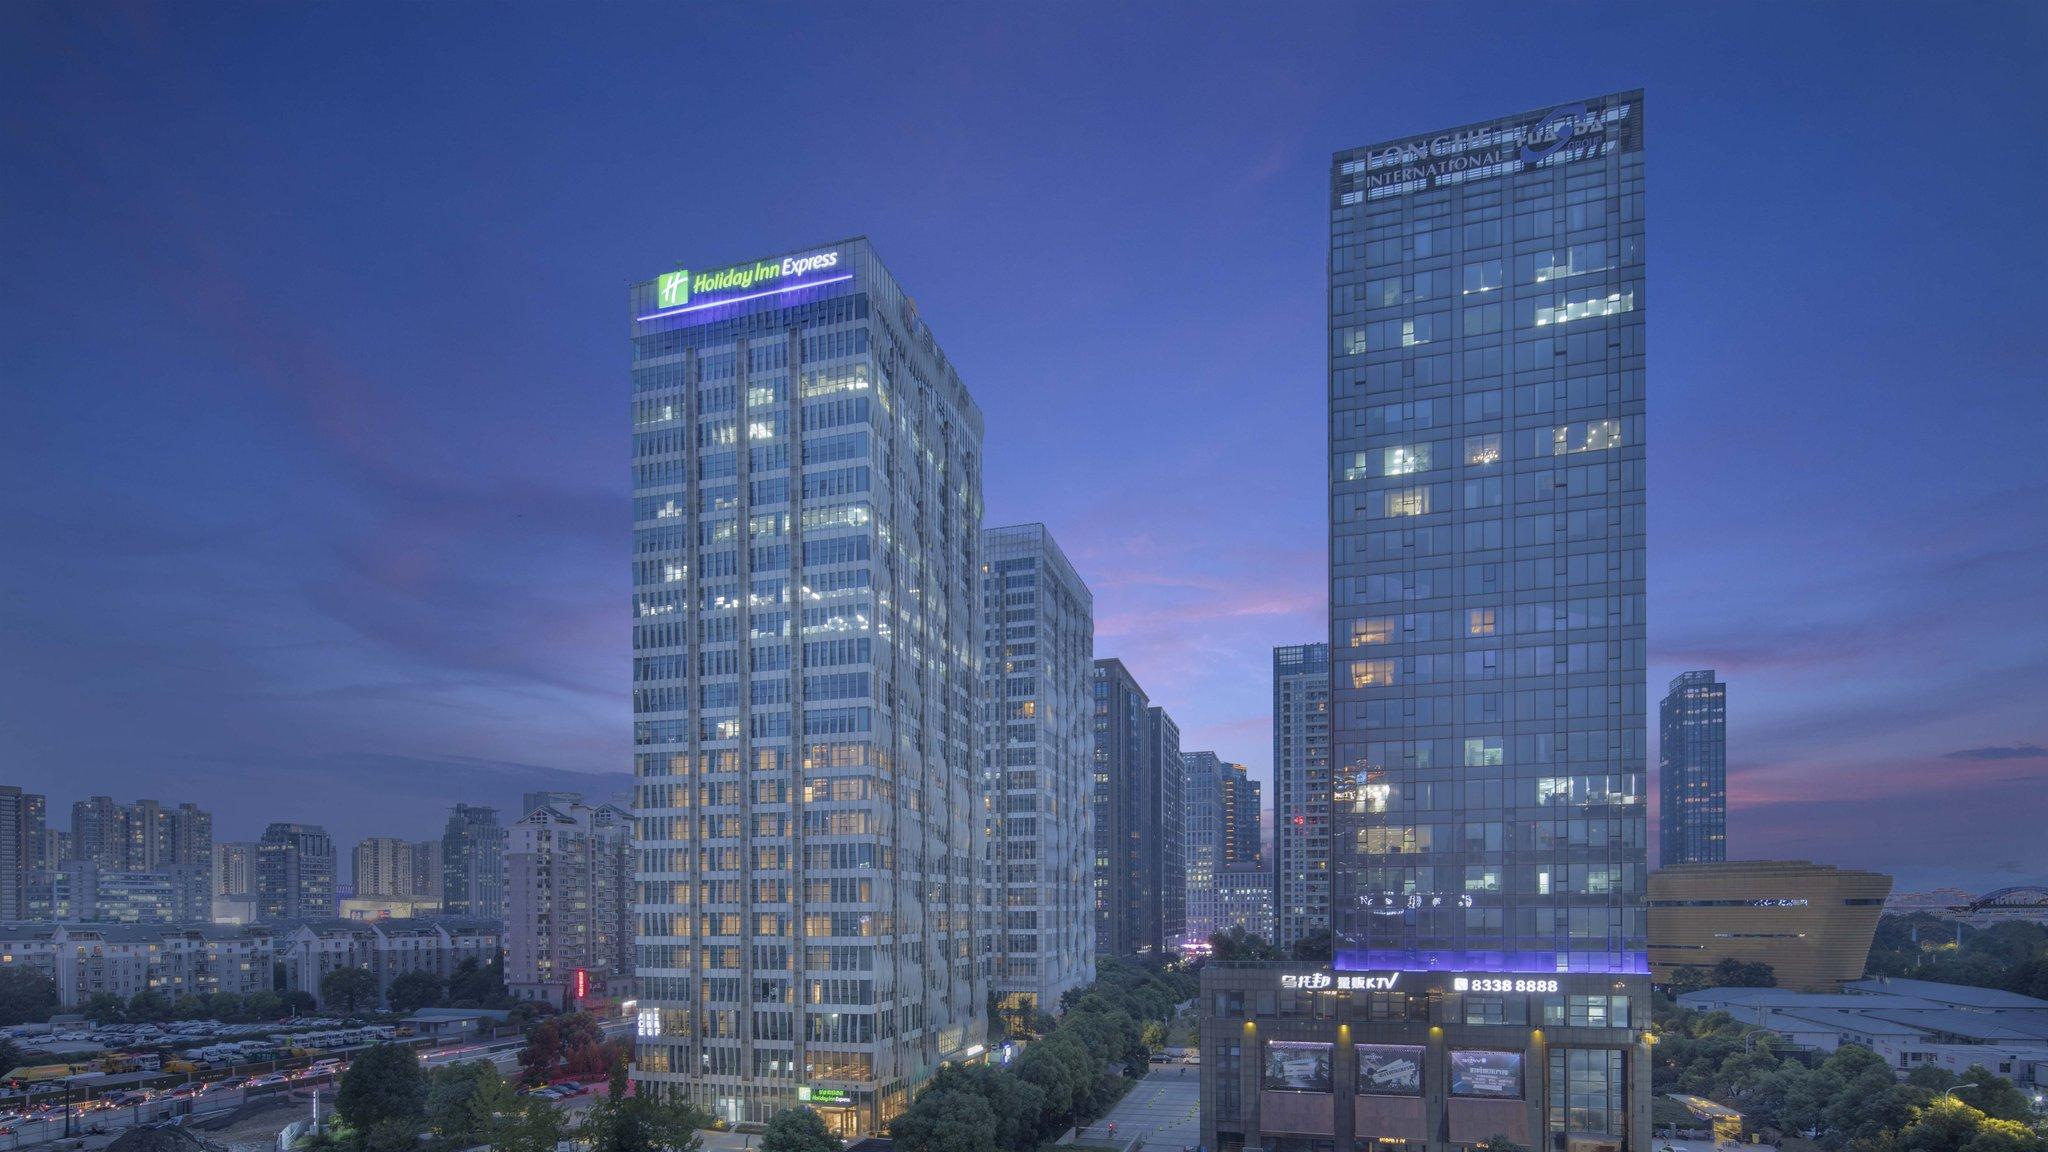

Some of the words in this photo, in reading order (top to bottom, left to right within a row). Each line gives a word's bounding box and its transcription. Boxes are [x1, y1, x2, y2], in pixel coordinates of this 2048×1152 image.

[1366, 150, 1503, 188] INTERNATIONAL
[693, 268, 753, 294] Holiday
[754, 262, 780, 282] Inn
[781, 252, 838, 277] Express
[1471, 979, 1512, 992] 8338
[1515, 979, 1558, 992] 8888
